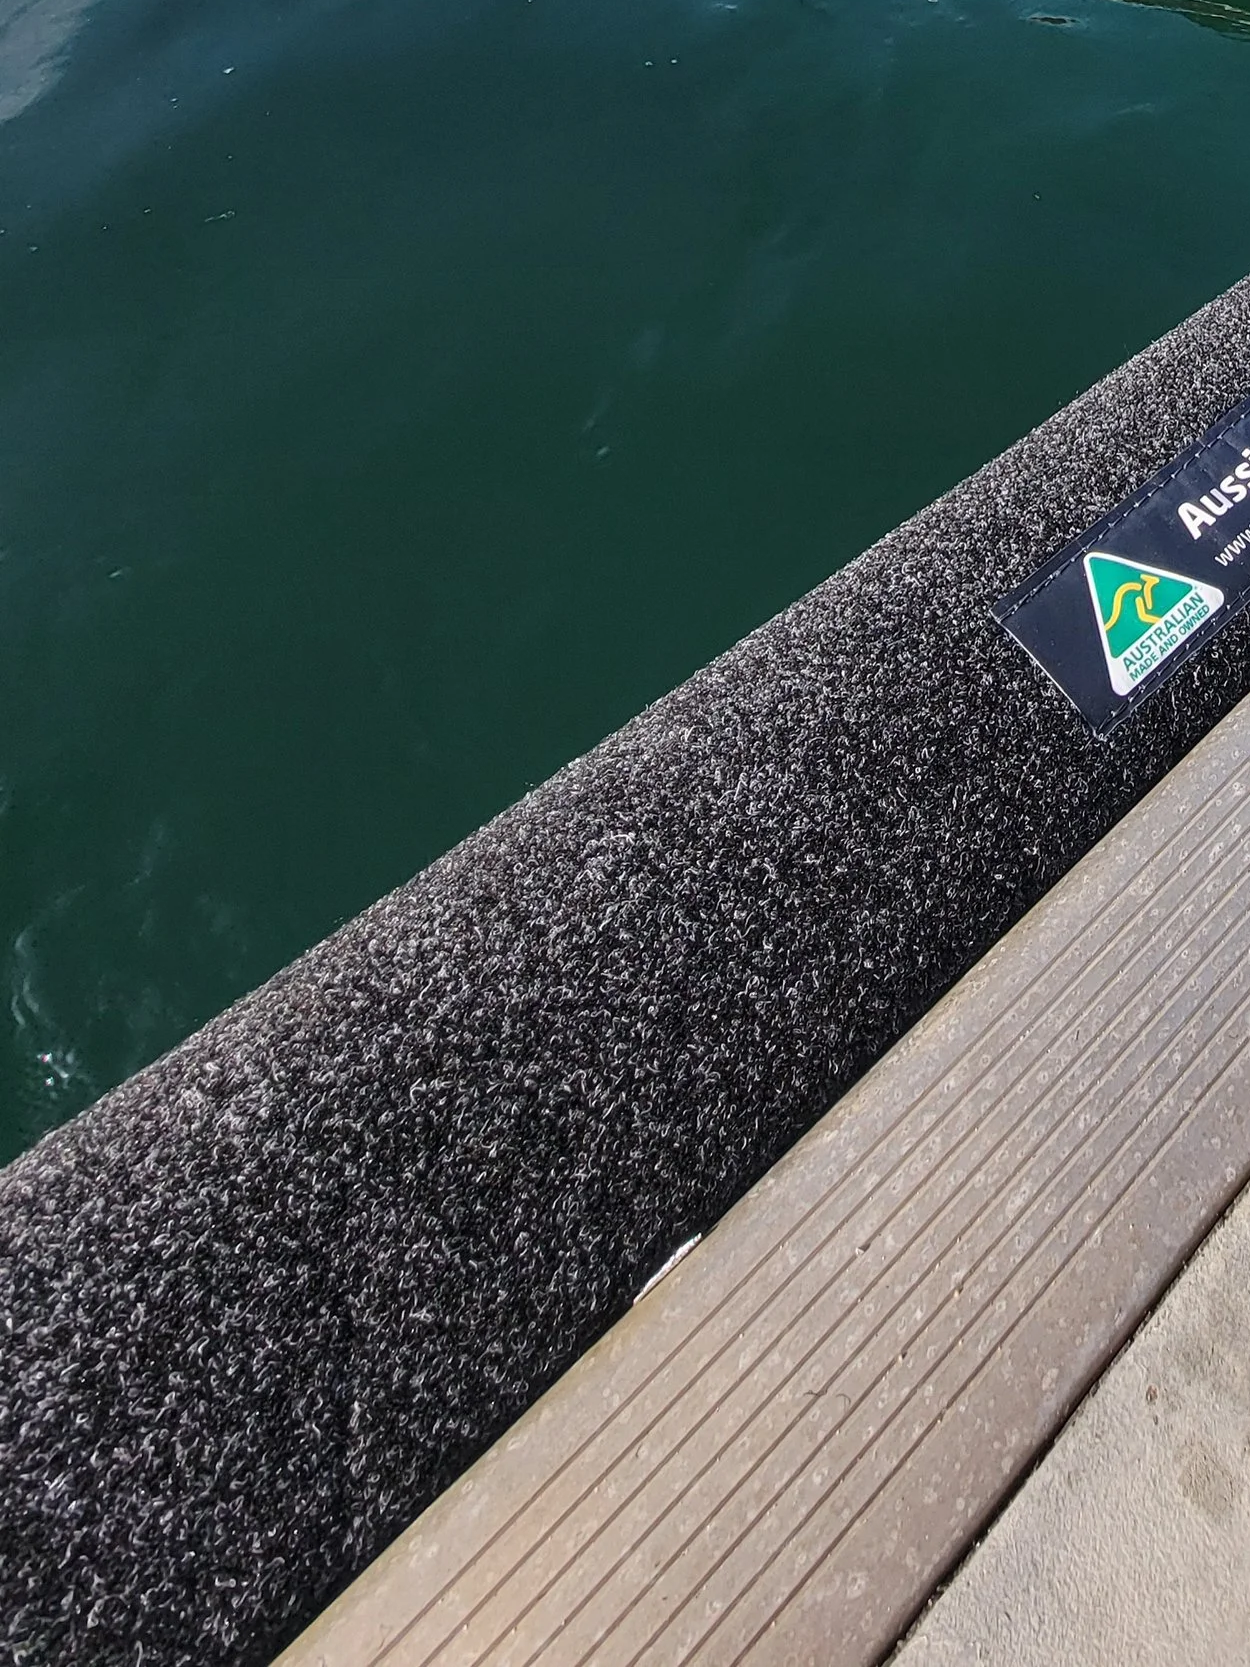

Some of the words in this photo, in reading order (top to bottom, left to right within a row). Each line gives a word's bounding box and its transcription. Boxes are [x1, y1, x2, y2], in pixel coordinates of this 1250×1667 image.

[1123, 592, 1204, 672] AUSTRALIAN
[1129, 653, 1159, 681] MADE
[1159, 633, 1179, 655] AND
[1178, 604, 1210, 636] OWNED
